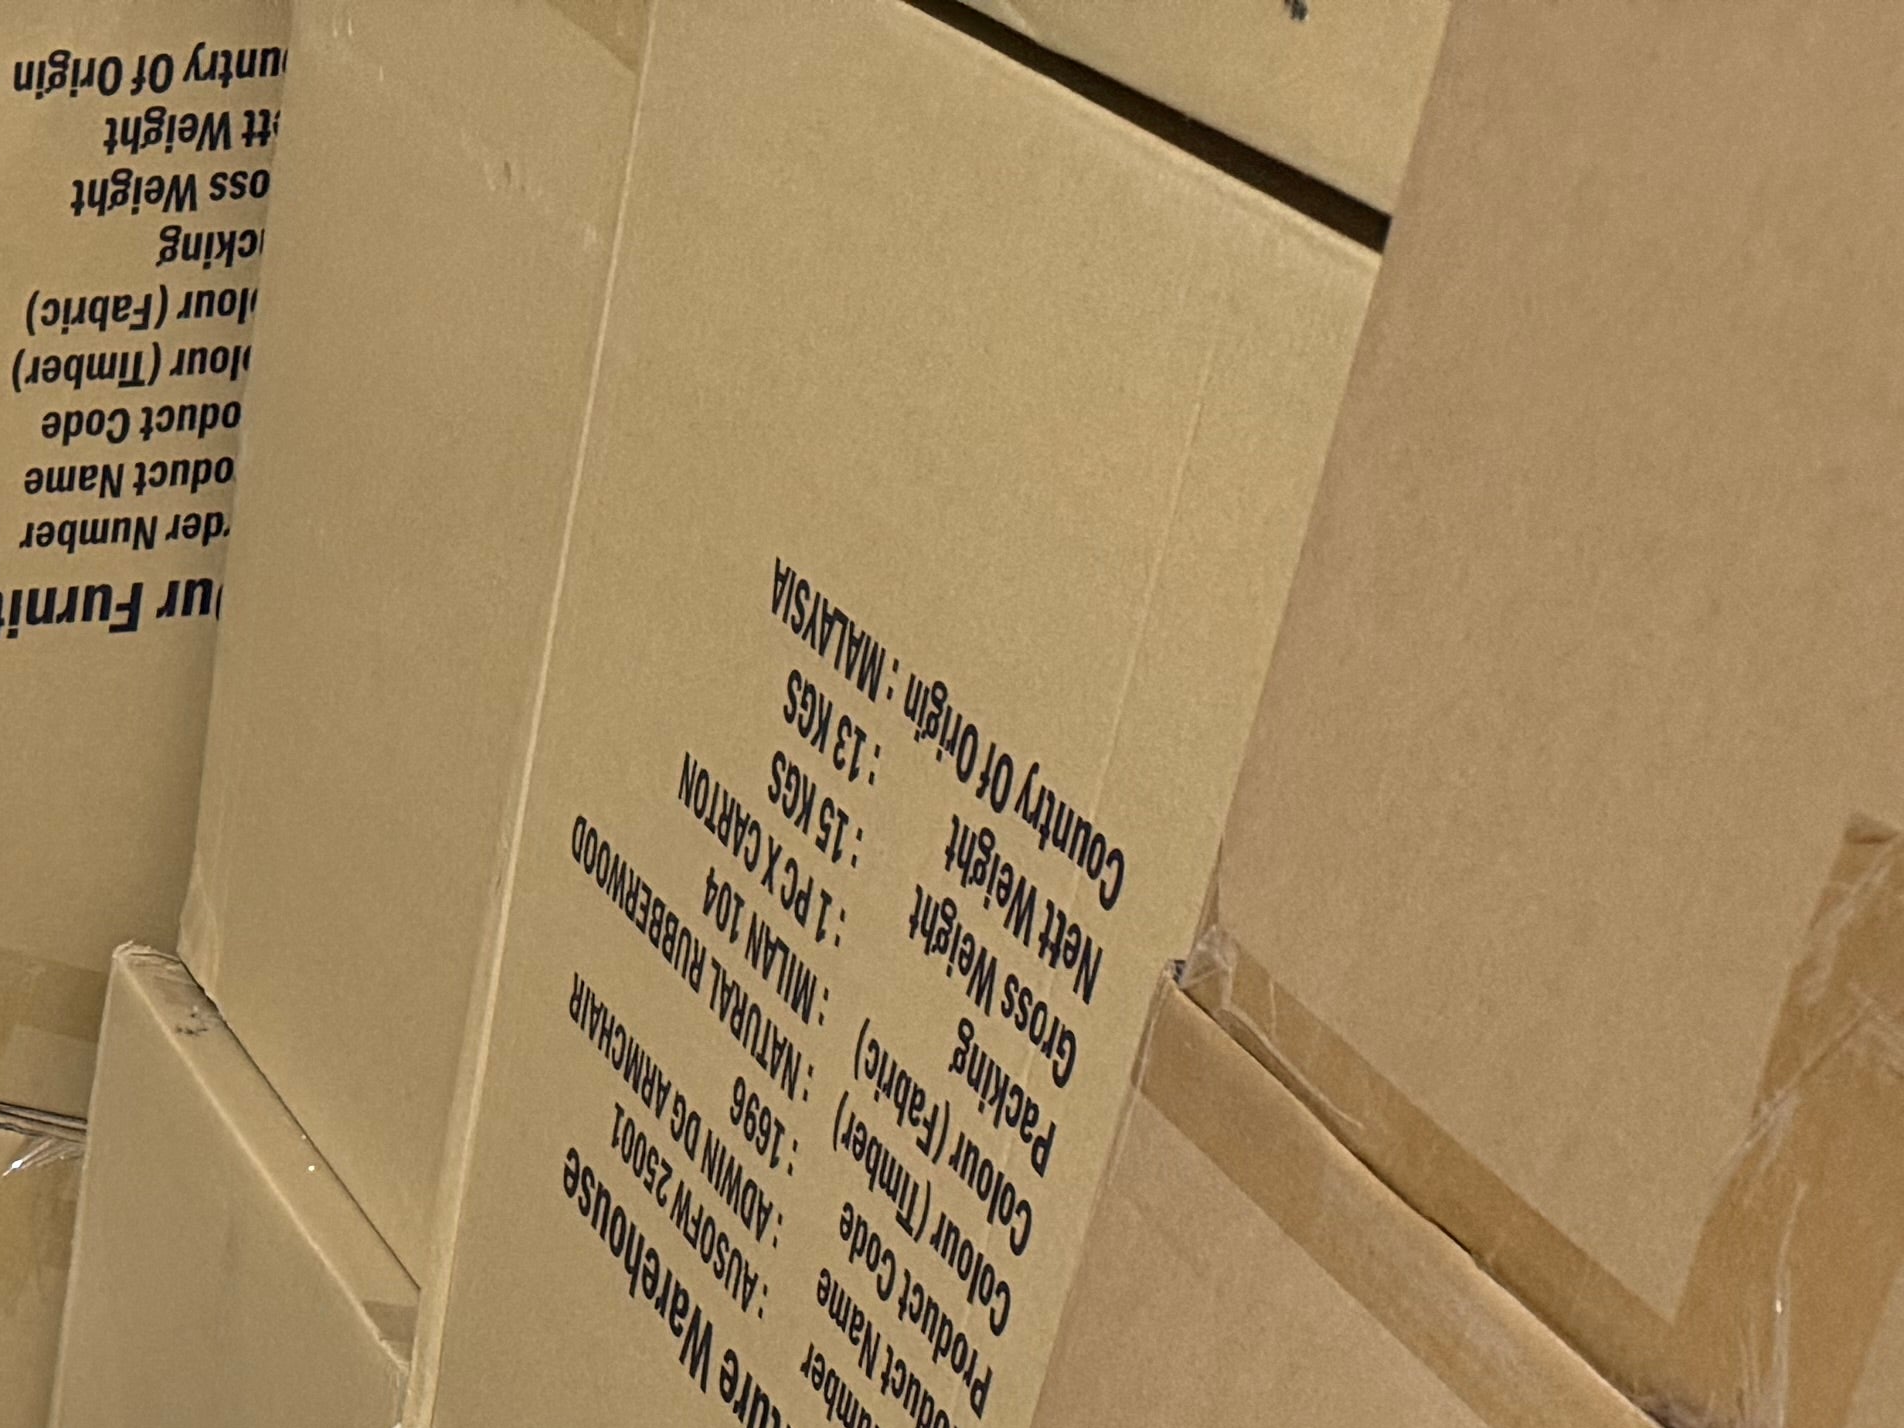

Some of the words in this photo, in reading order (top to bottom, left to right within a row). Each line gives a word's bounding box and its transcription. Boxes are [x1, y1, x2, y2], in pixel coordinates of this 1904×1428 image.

[12, 48, 125, 101] Origin
[129, 52, 175, 97] Of
[181, 41, 289, 89] untry
[10, 340, 162, 394] (Timber)
[168, 344, 253, 382] lour
[40, 406, 131, 447] Code
[138, 400, 243, 442] oduct
[18, 514, 159, 555] Number
[165, 511, 231, 548] der
[571, 814, 707, 994] RUBBERWOOD
[702, 866, 746, 945] 104
[744, 911, 818, 1025] MILAN
[568, 971, 673, 1120] ARMCHAIR
[709, 956, 803, 1102] NATURAL
[669, 1090, 702, 1162] DG
[853, 1017, 951, 1165] (Fabric)
[700, 1128, 774, 1244] ADWIN
[832, 1089, 932, 1244] (Timber)
[947, 1130, 1033, 1257] Colour
[562, 1146, 714, 1395] Warehouse
[928, 1211, 1011, 1337] Colour
[816, 1267, 882, 1381] Name
